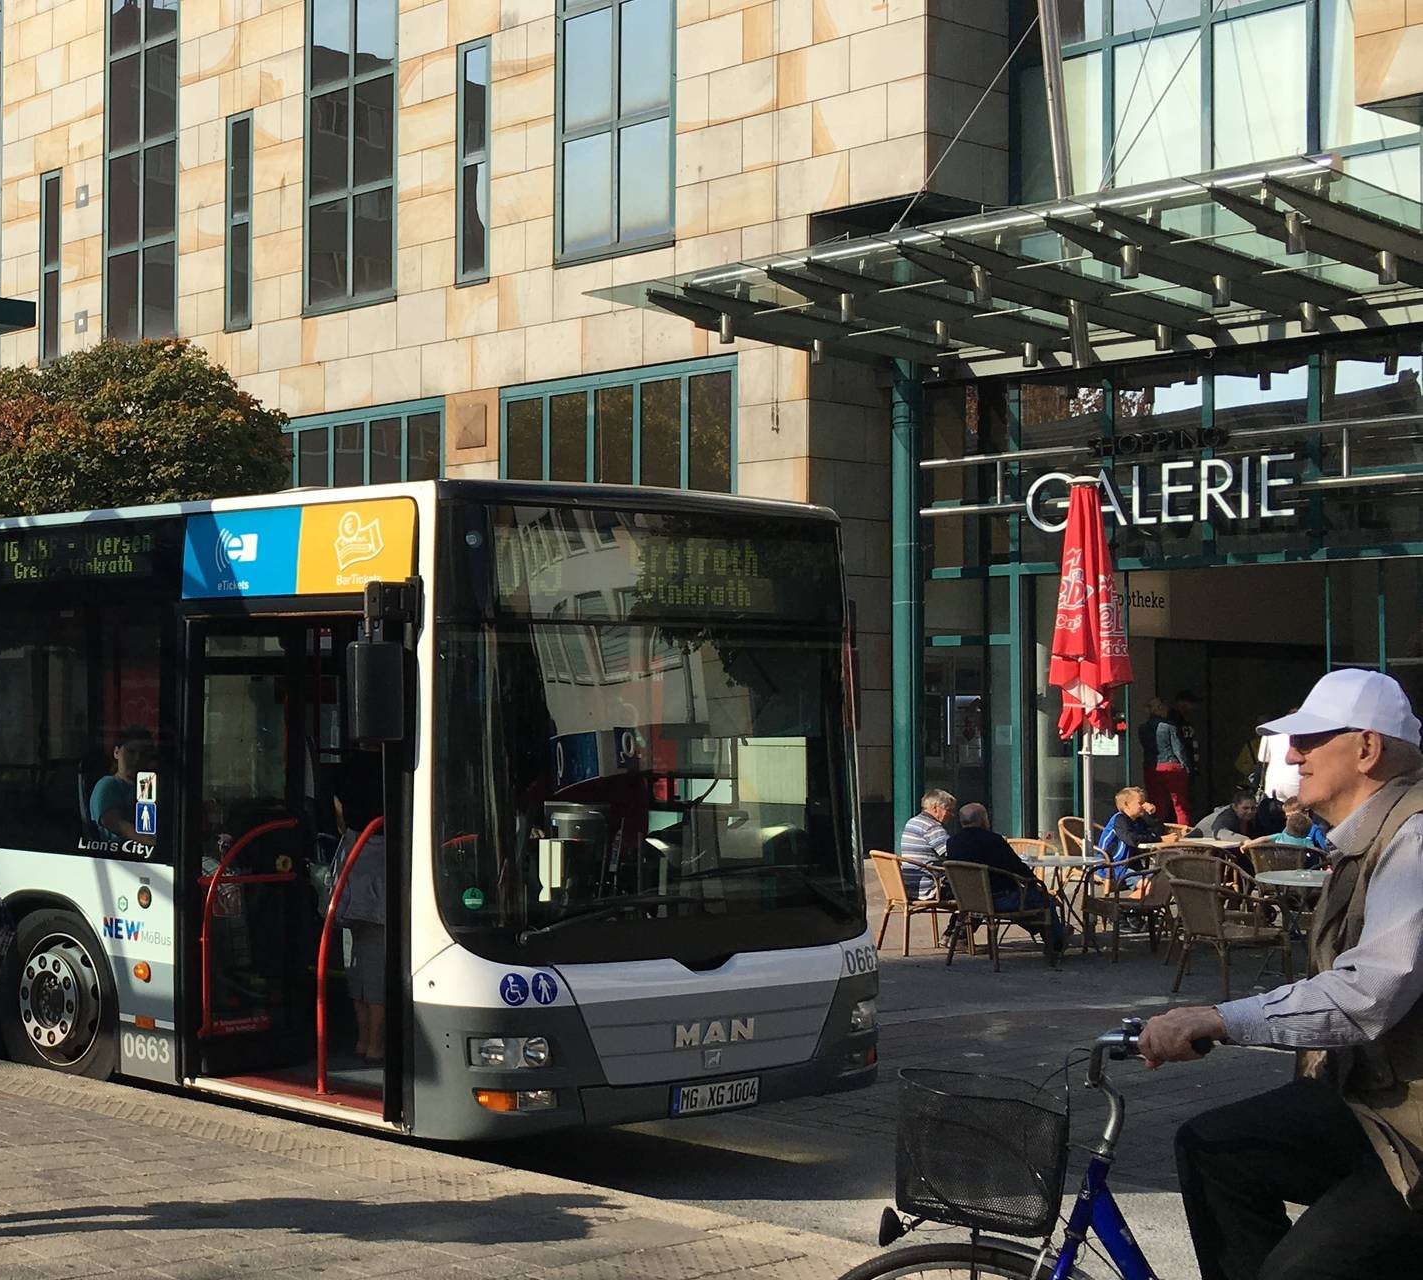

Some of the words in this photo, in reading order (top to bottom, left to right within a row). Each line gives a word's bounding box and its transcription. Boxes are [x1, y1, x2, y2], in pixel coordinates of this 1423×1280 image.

[1026, 452, 1296, 533] GALERIE
[217, 579, 250, 591] eTickets
[77, 836, 119, 853] Lion's
[121, 839, 155, 859] City
[102, 916, 141, 942] NEW
[123, 1032, 170, 1064] 0663
[674, 1017, 756, 1048] MAN
[680, 1088, 699, 1111] MG
[707, 1083, 725, 1105] XG
[728, 1080, 758, 1102] 1004
